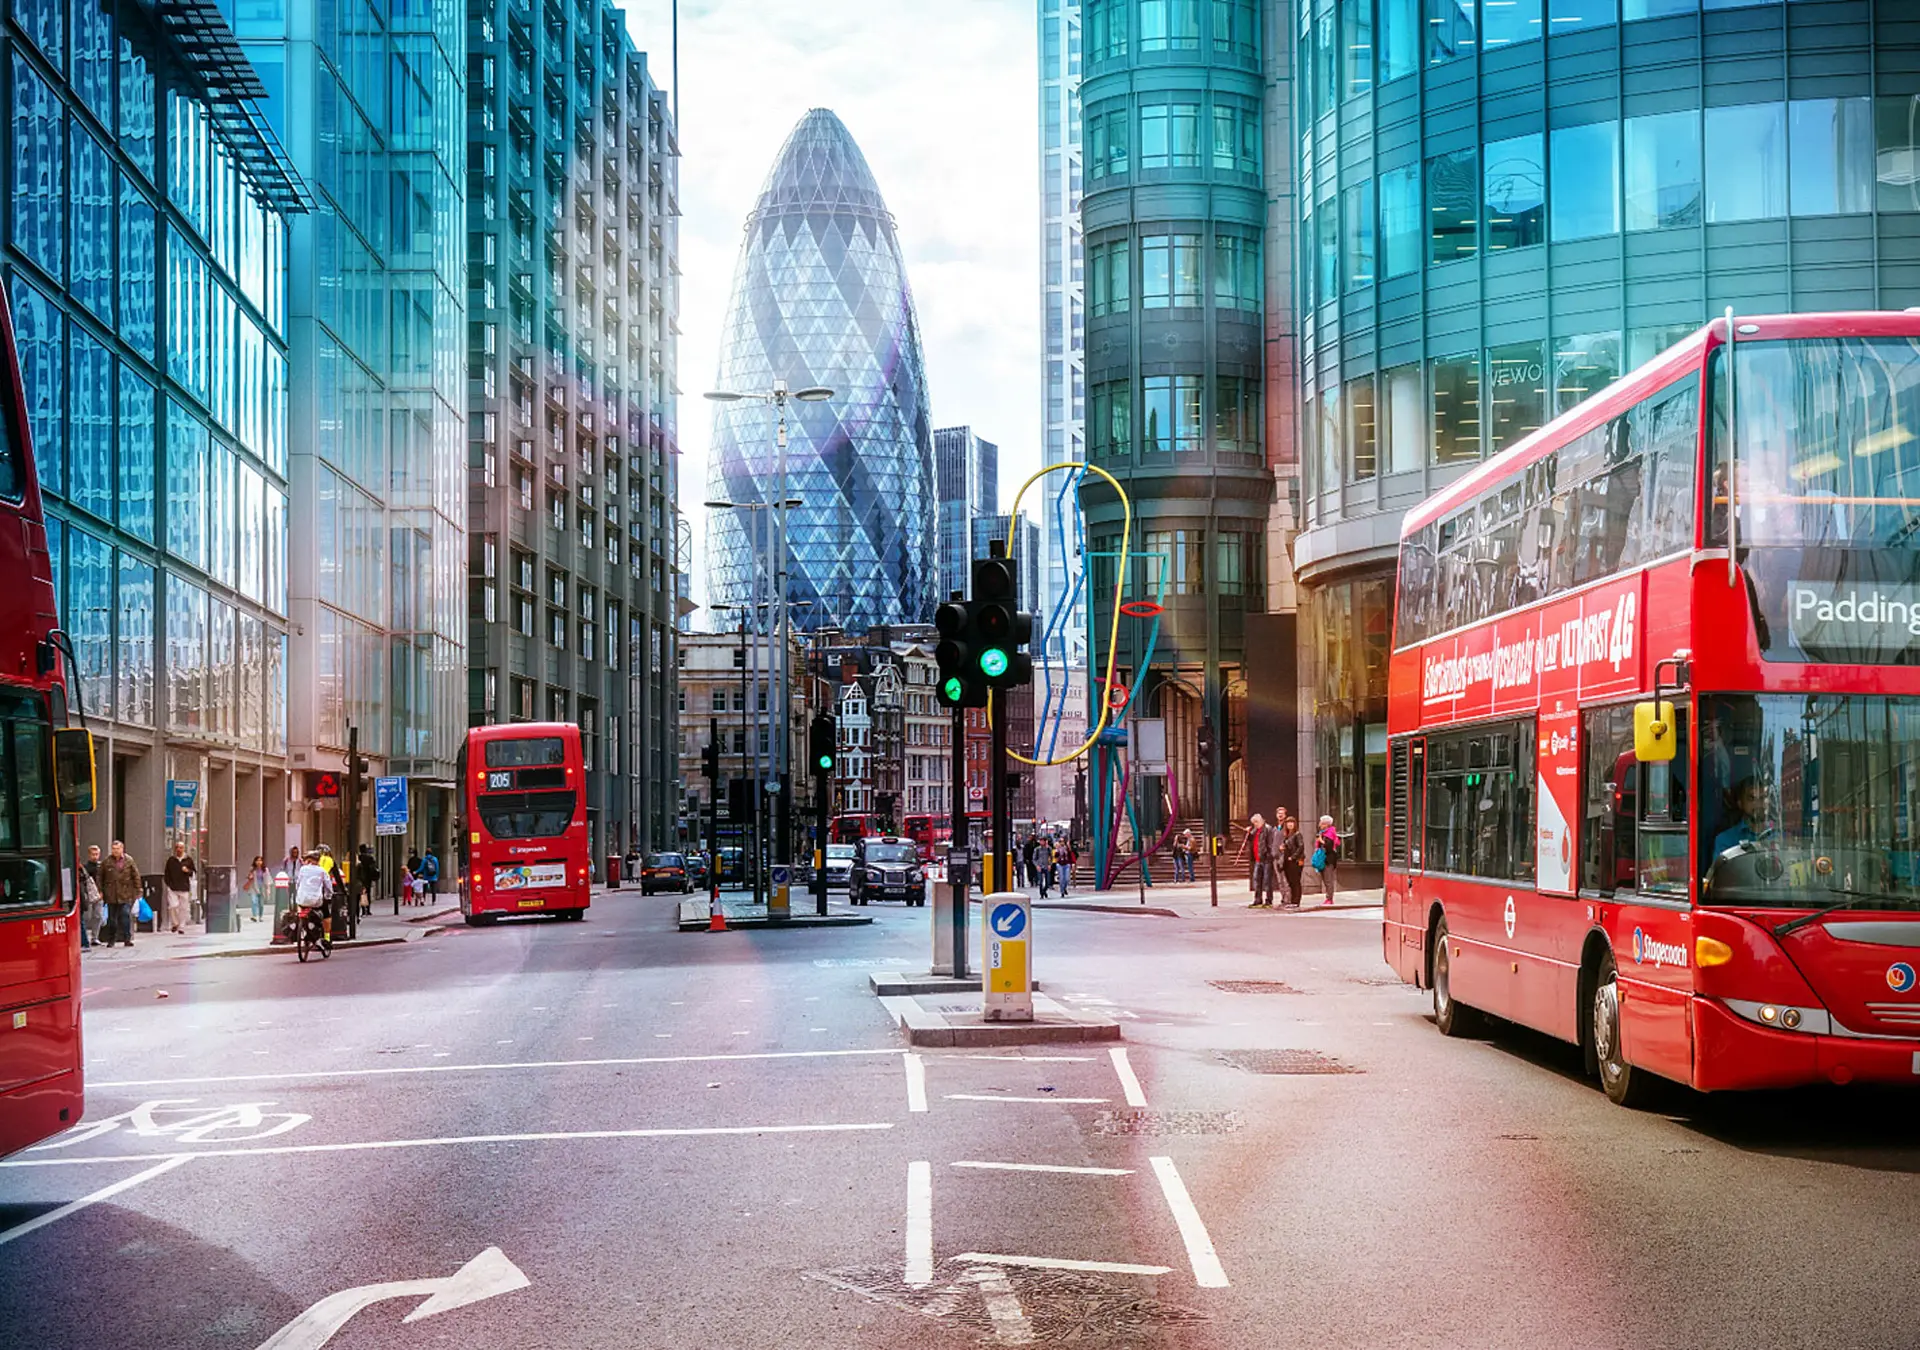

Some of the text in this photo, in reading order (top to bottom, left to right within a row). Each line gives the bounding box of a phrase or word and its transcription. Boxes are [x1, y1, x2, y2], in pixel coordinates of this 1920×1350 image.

[1491, 358, 1568, 387] EWOK
[1609, 592, 1635, 673] 4G
[490, 772, 510, 788] 205
[55, 917, 67, 934] 455
[1644, 933, 1688, 969] Stagecoach
